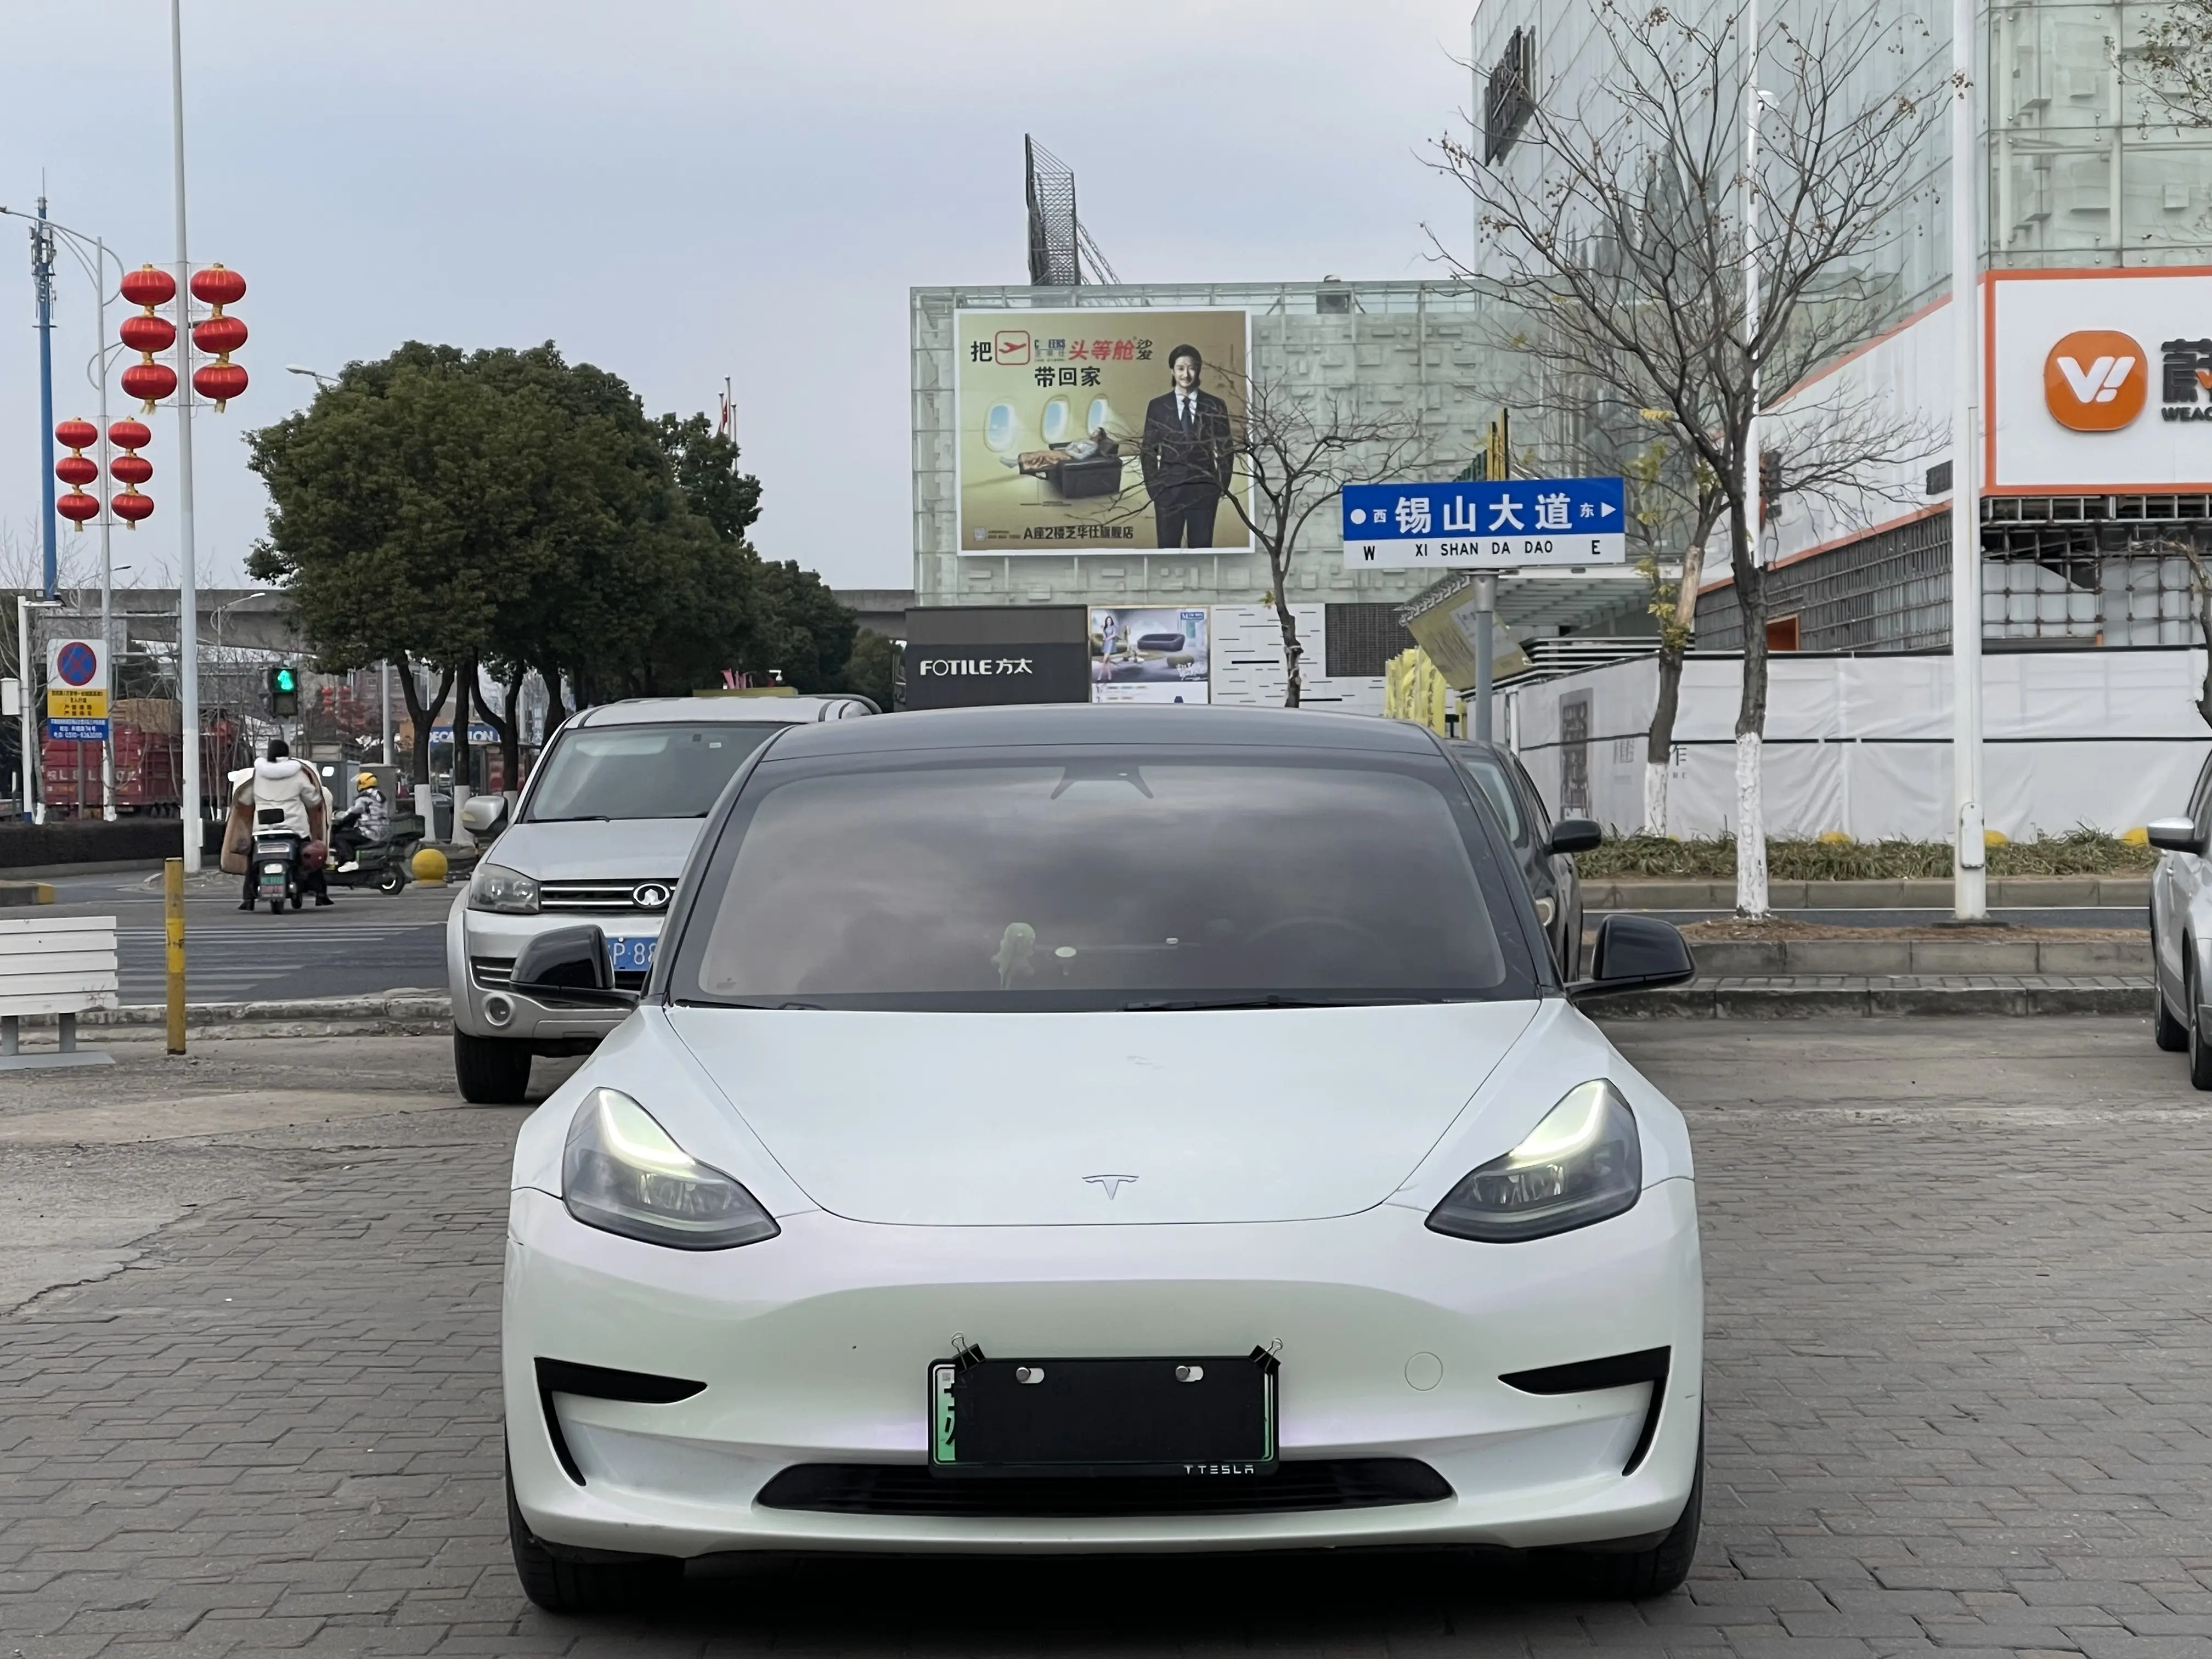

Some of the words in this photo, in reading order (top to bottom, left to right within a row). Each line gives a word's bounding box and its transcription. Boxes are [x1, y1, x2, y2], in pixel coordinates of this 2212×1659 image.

[971, 341, 992, 362] 把
[1069, 339, 1134, 361] 头等舱
[1136, 338, 1153, 360] 沙发
[1035, 366, 1101, 387] 带回家
[1373, 509, 1387, 523] 西
[1395, 492, 1572, 534] 锡山大道
[1580, 502, 1594, 518] 东
[1363, 546, 1375, 561] W
[1415, 544, 1427, 557] XI
[1441, 542, 1479, 556] SHAN
[1492, 541, 1511, 555] DA
[1525, 540, 1553, 554] DAO
[1592, 540, 1600, 555] E
[920, 659, 992, 676] FOTILE
[996, 658, 1033, 675] 方太
